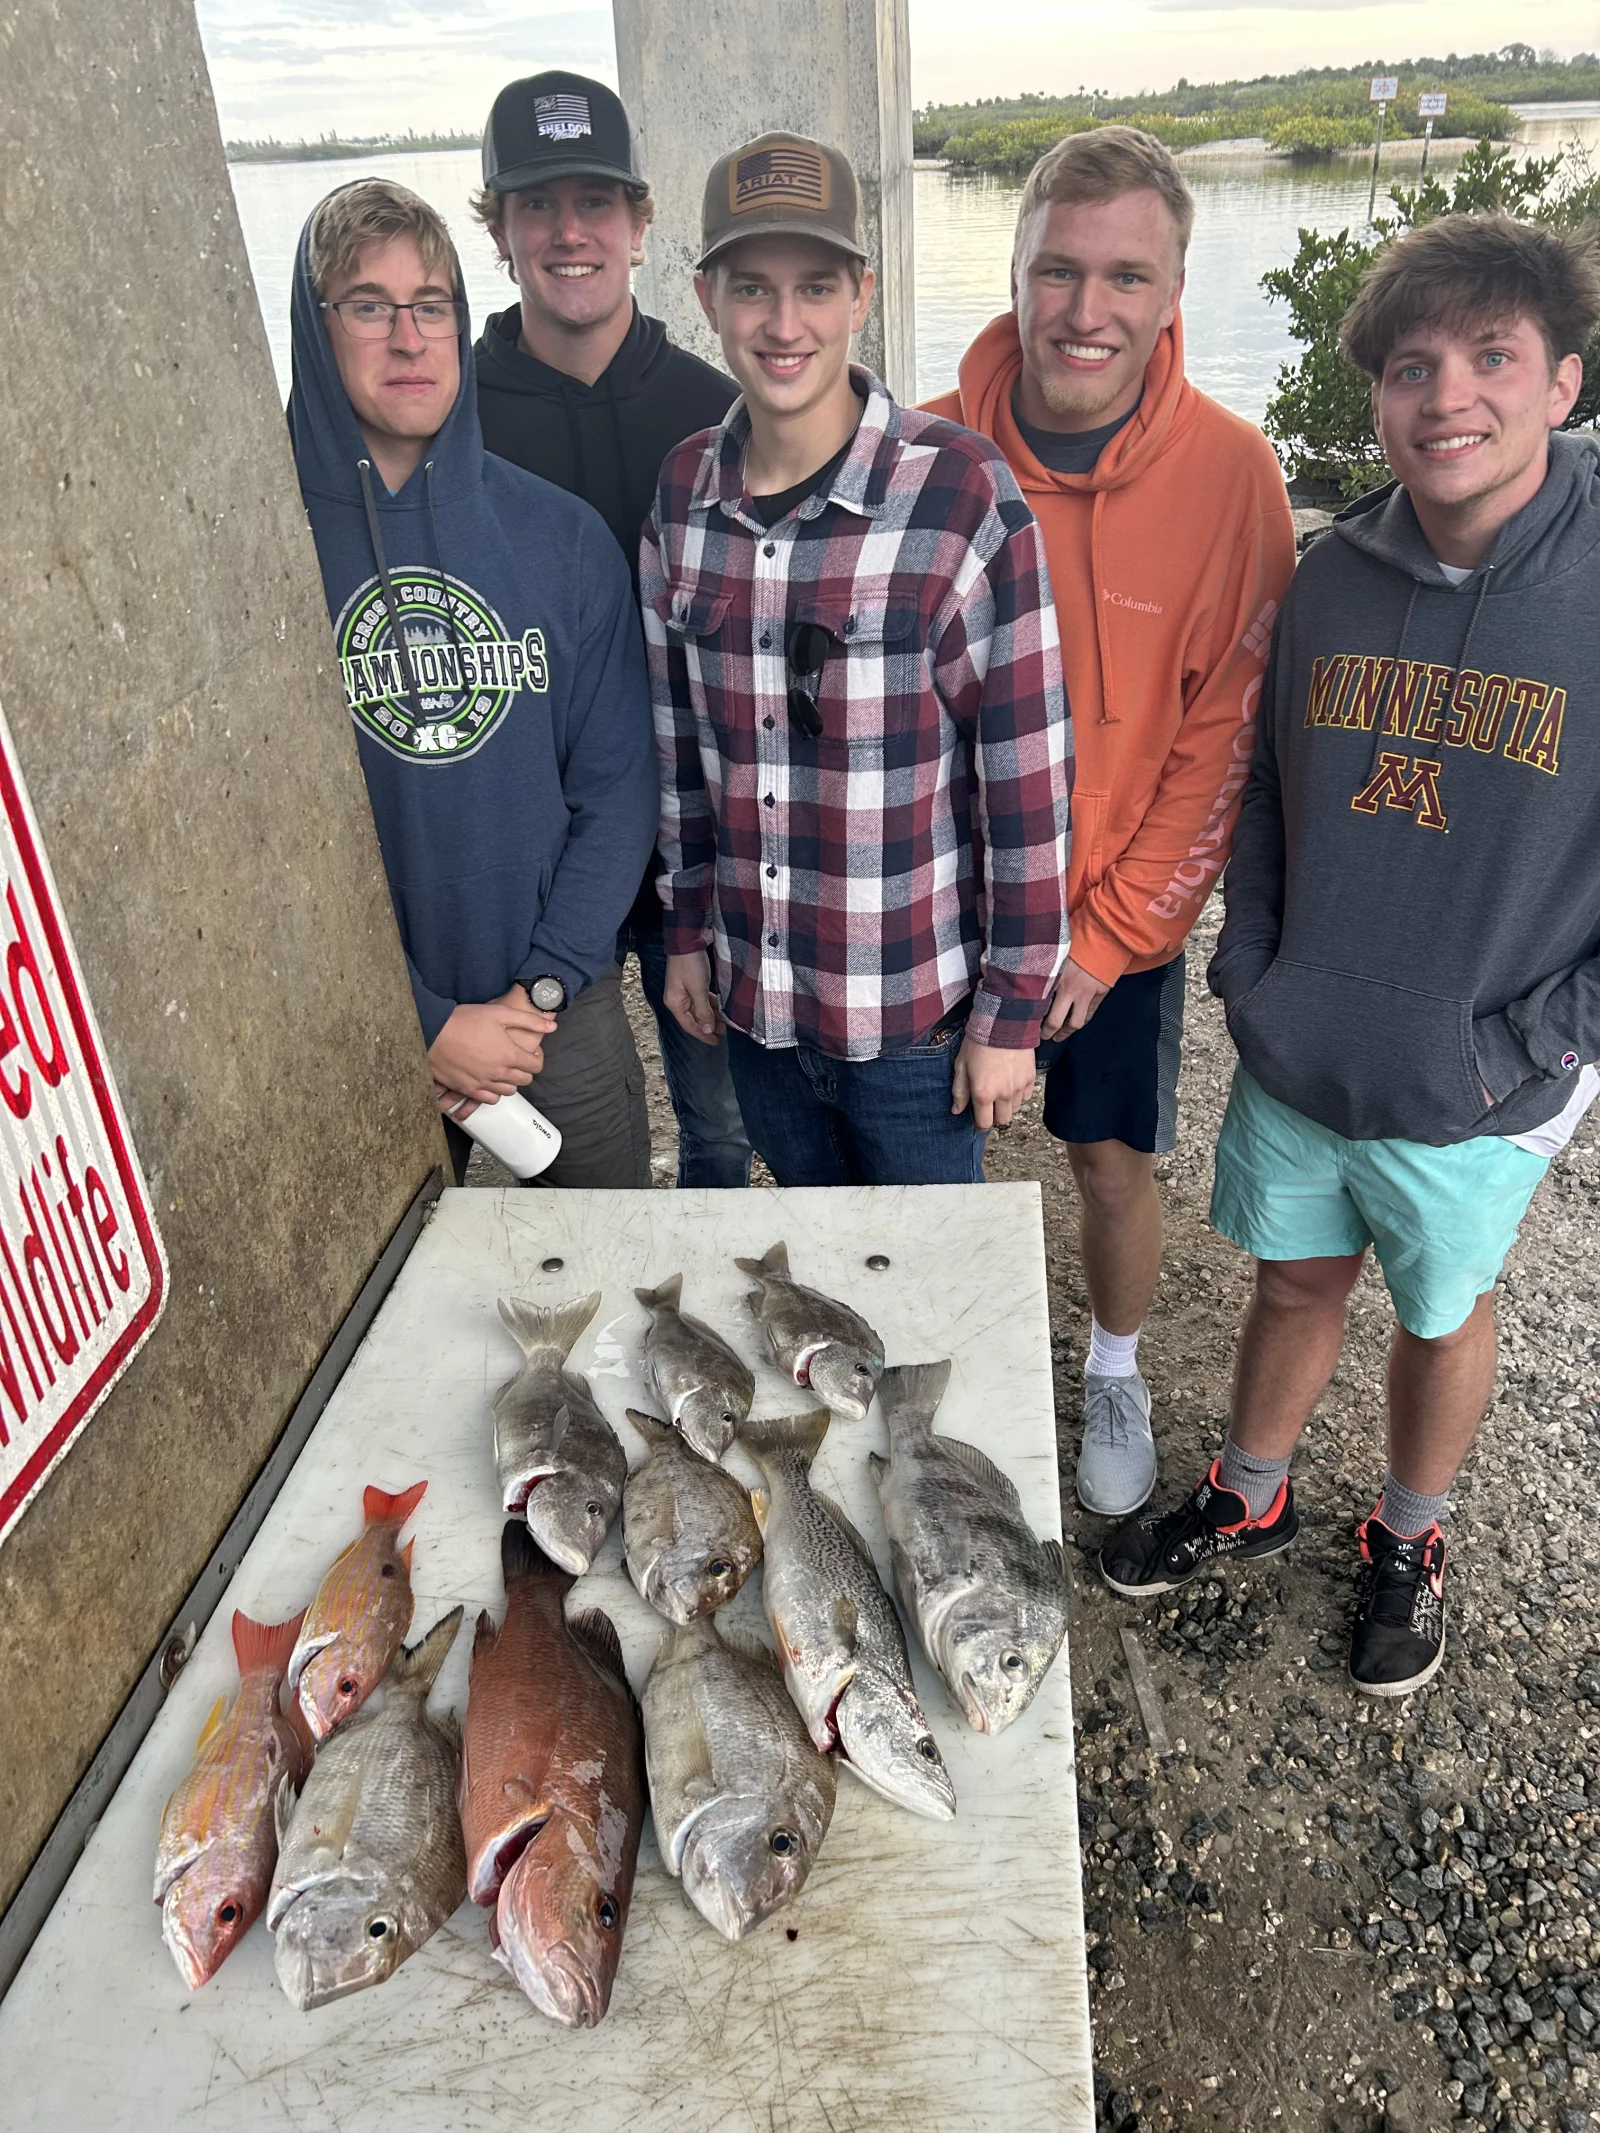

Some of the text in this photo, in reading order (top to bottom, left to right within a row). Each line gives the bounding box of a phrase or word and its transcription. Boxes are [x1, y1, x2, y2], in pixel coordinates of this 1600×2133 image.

[538, 123, 592, 136] SHELDON
[737, 173, 797, 195] ARIAT
[400, 585, 490, 639] COUNTRY
[1110, 592, 1163, 615] Columbia
[339, 628, 549, 707] AMIONSHIPS
[1304, 654, 1567, 775] MINNESOTA
[415, 723, 462, 753] XC
[1351, 752, 1447, 830] M
[532, 1118, 552, 1139] owala
